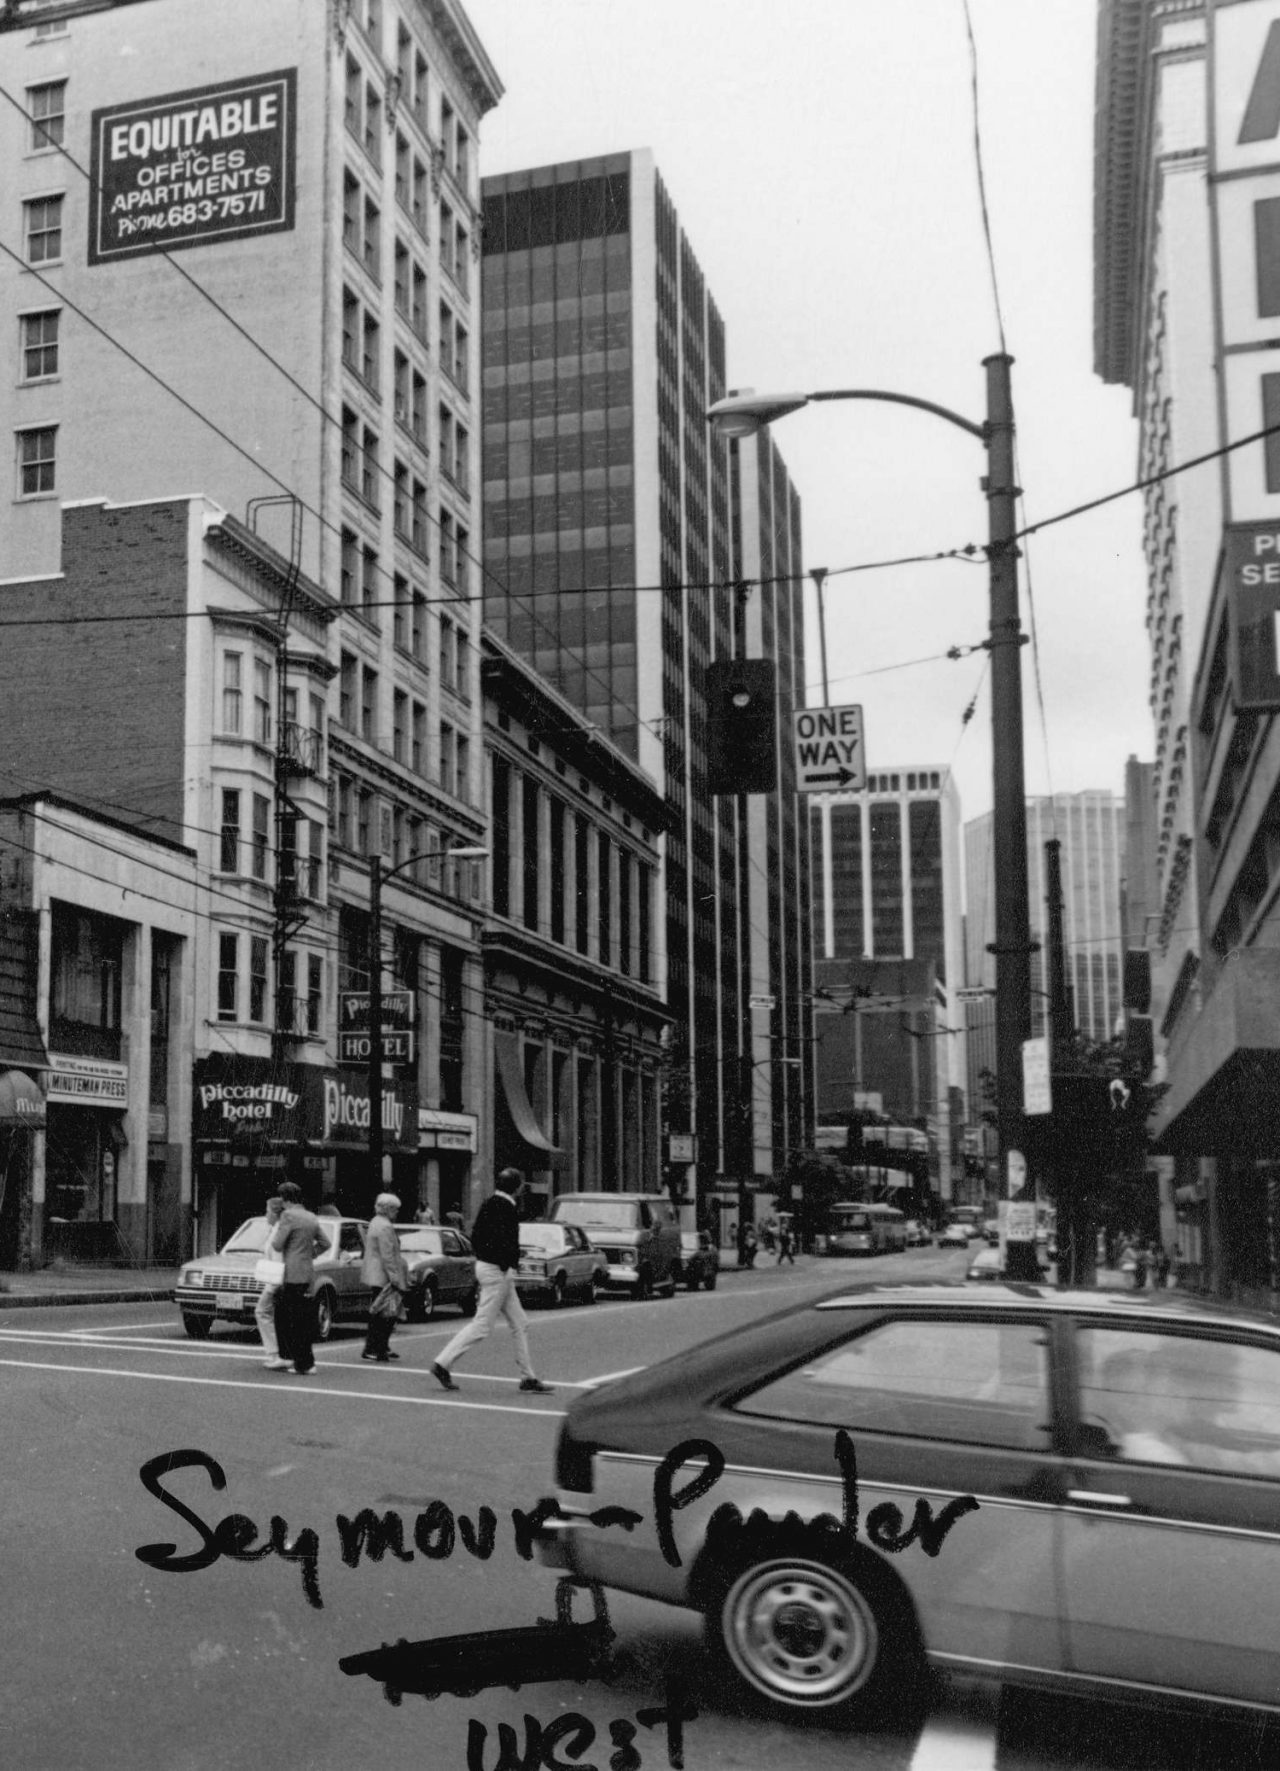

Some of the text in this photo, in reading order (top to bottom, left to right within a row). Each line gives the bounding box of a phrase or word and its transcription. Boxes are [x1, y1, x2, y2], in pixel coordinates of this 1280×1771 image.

[111, 93, 278, 161] EQUITABLE
[136, 149, 246, 187] OFFICES
[176, 146, 203, 162] for
[111, 165, 272, 214] APARTMENTS
[118, 189, 266, 238] Phone 683-7571
[796, 710, 858, 739] ONE
[798, 739, 859, 767] WAY
[346, 1038, 407, 1056] HOEL
[52, 1074, 126, 1097] MINUTEMAN PRESS
[323, 1077, 404, 1142] Piccailly
